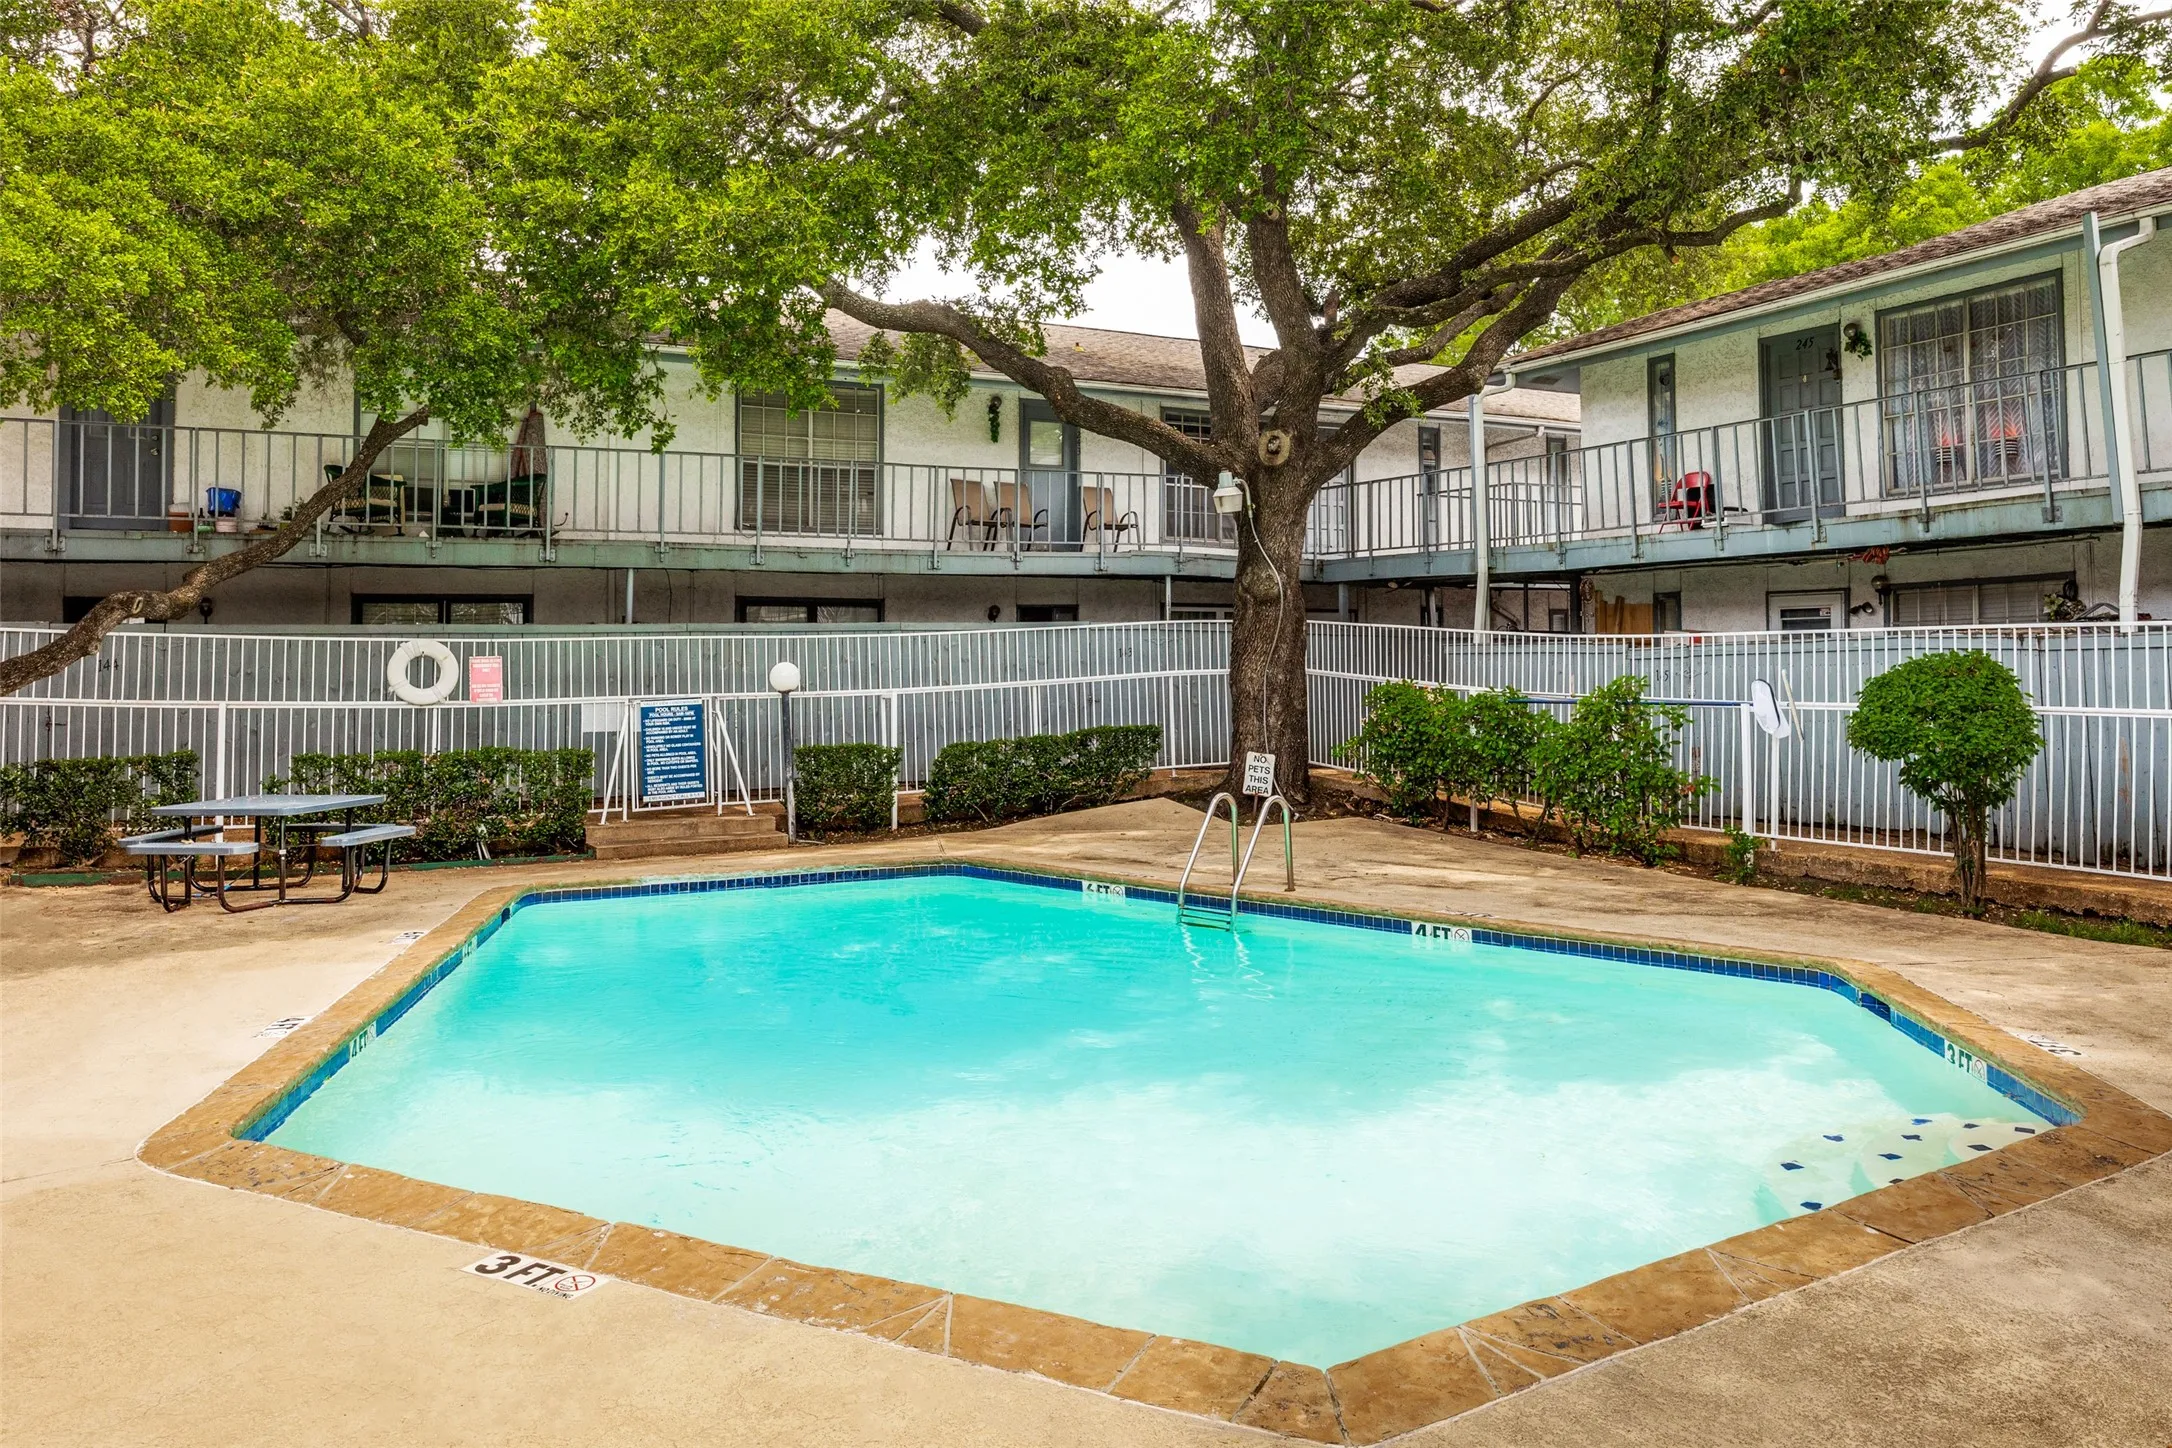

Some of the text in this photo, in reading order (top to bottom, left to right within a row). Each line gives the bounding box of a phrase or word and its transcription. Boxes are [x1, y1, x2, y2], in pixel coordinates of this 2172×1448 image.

[1796, 336, 1814, 350] 245
[1656, 670, 1668, 681] 15
[1253, 755, 1267, 763] NO
[1249, 765, 1270, 774] PETS
[1249, 775, 1268, 784] THIS
[1245, 785, 1269, 794] AREA
[1433, 926, 1450, 939] FT
[1947, 1043, 1972, 1073] 3 FT
[474, 1256, 521, 1274] 3
